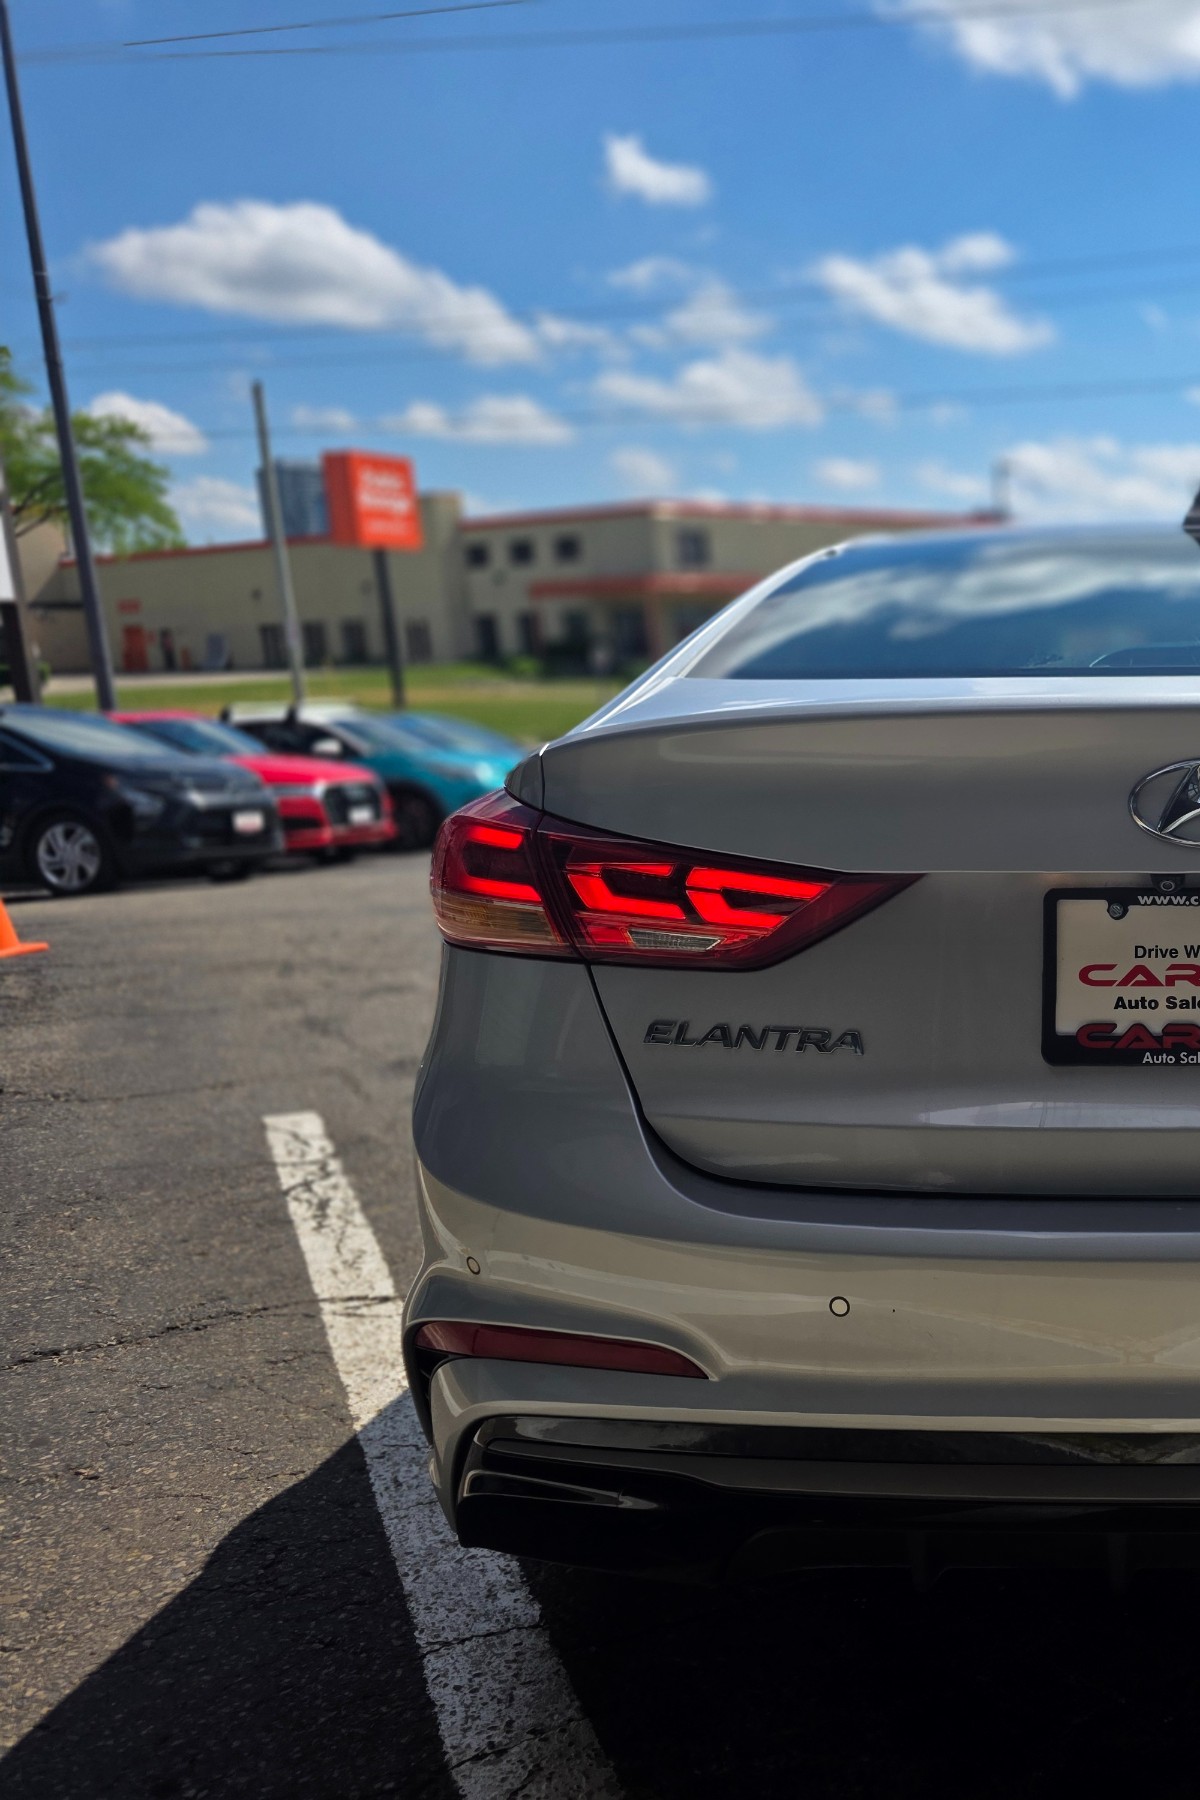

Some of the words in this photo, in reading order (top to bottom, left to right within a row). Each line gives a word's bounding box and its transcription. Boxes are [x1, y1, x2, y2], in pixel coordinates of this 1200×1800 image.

[1134, 945, 1179, 959] Drive
[1113, 996, 1160, 1010] Auto
[643, 1018, 865, 1056] ELANTRA
[1142, 1052, 1176, 1065] Auto
